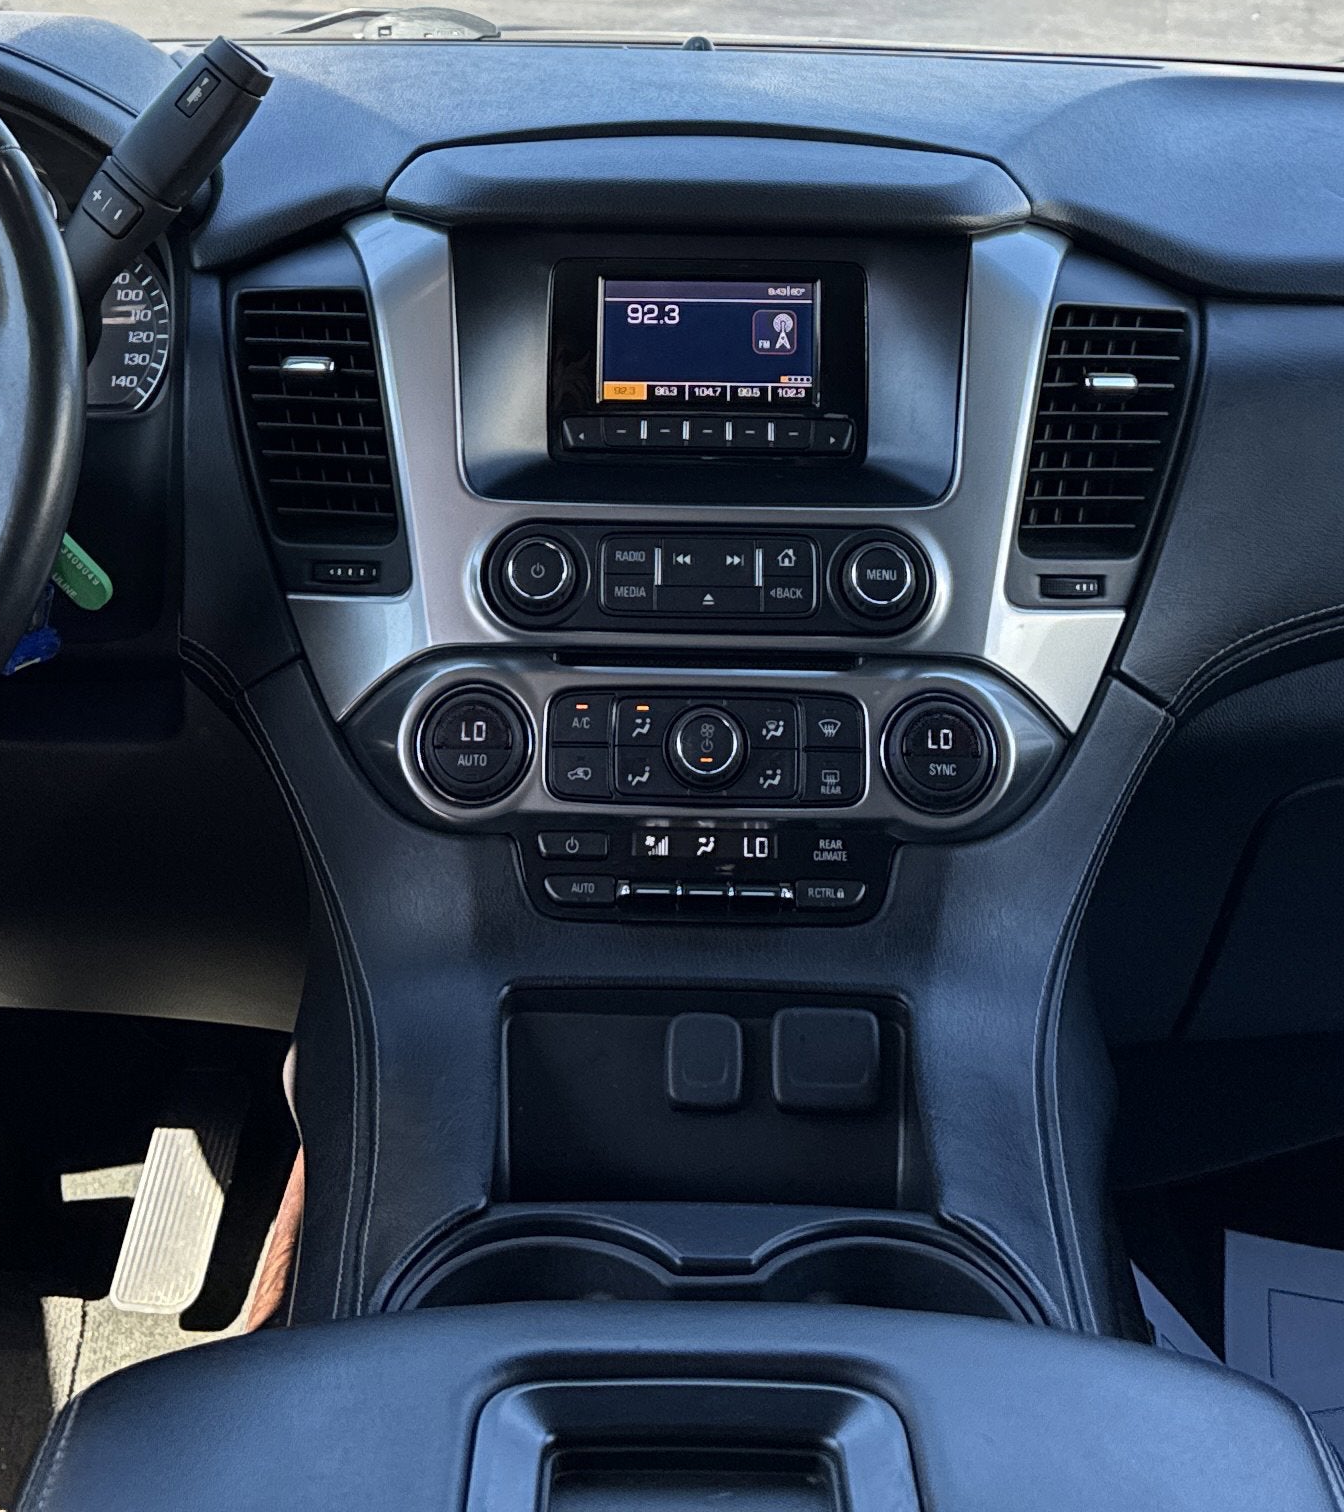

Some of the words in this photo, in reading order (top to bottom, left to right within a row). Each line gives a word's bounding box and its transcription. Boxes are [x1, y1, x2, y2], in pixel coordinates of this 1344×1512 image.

[117, 290, 143, 300] 100
[130, 310, 152, 321] 110
[627, 304, 680, 324] 92.3
[128, 332, 154, 343] 120
[758, 340, 770, 348] FM
[124, 353, 149, 365] 130
[112, 376, 138, 387] 140
[694, 387, 722, 397] 104.7
[778, 388, 806, 398] 102.3
[616, 550, 645, 562] RADIO
[867, 569, 896, 580] MENU
[614, 586, 646, 598] MEDIA
[776, 588, 803, 599] BACK
[572, 717, 590, 728] A/C
[457, 754, 488, 766] AUTO
[929, 763, 956, 776] SYNC
[820, 786, 842, 794] REAR
[820, 839, 842, 850] REAR
[813, 850, 848, 862] CLIMATE
[571, 882, 594, 893] AUTO
